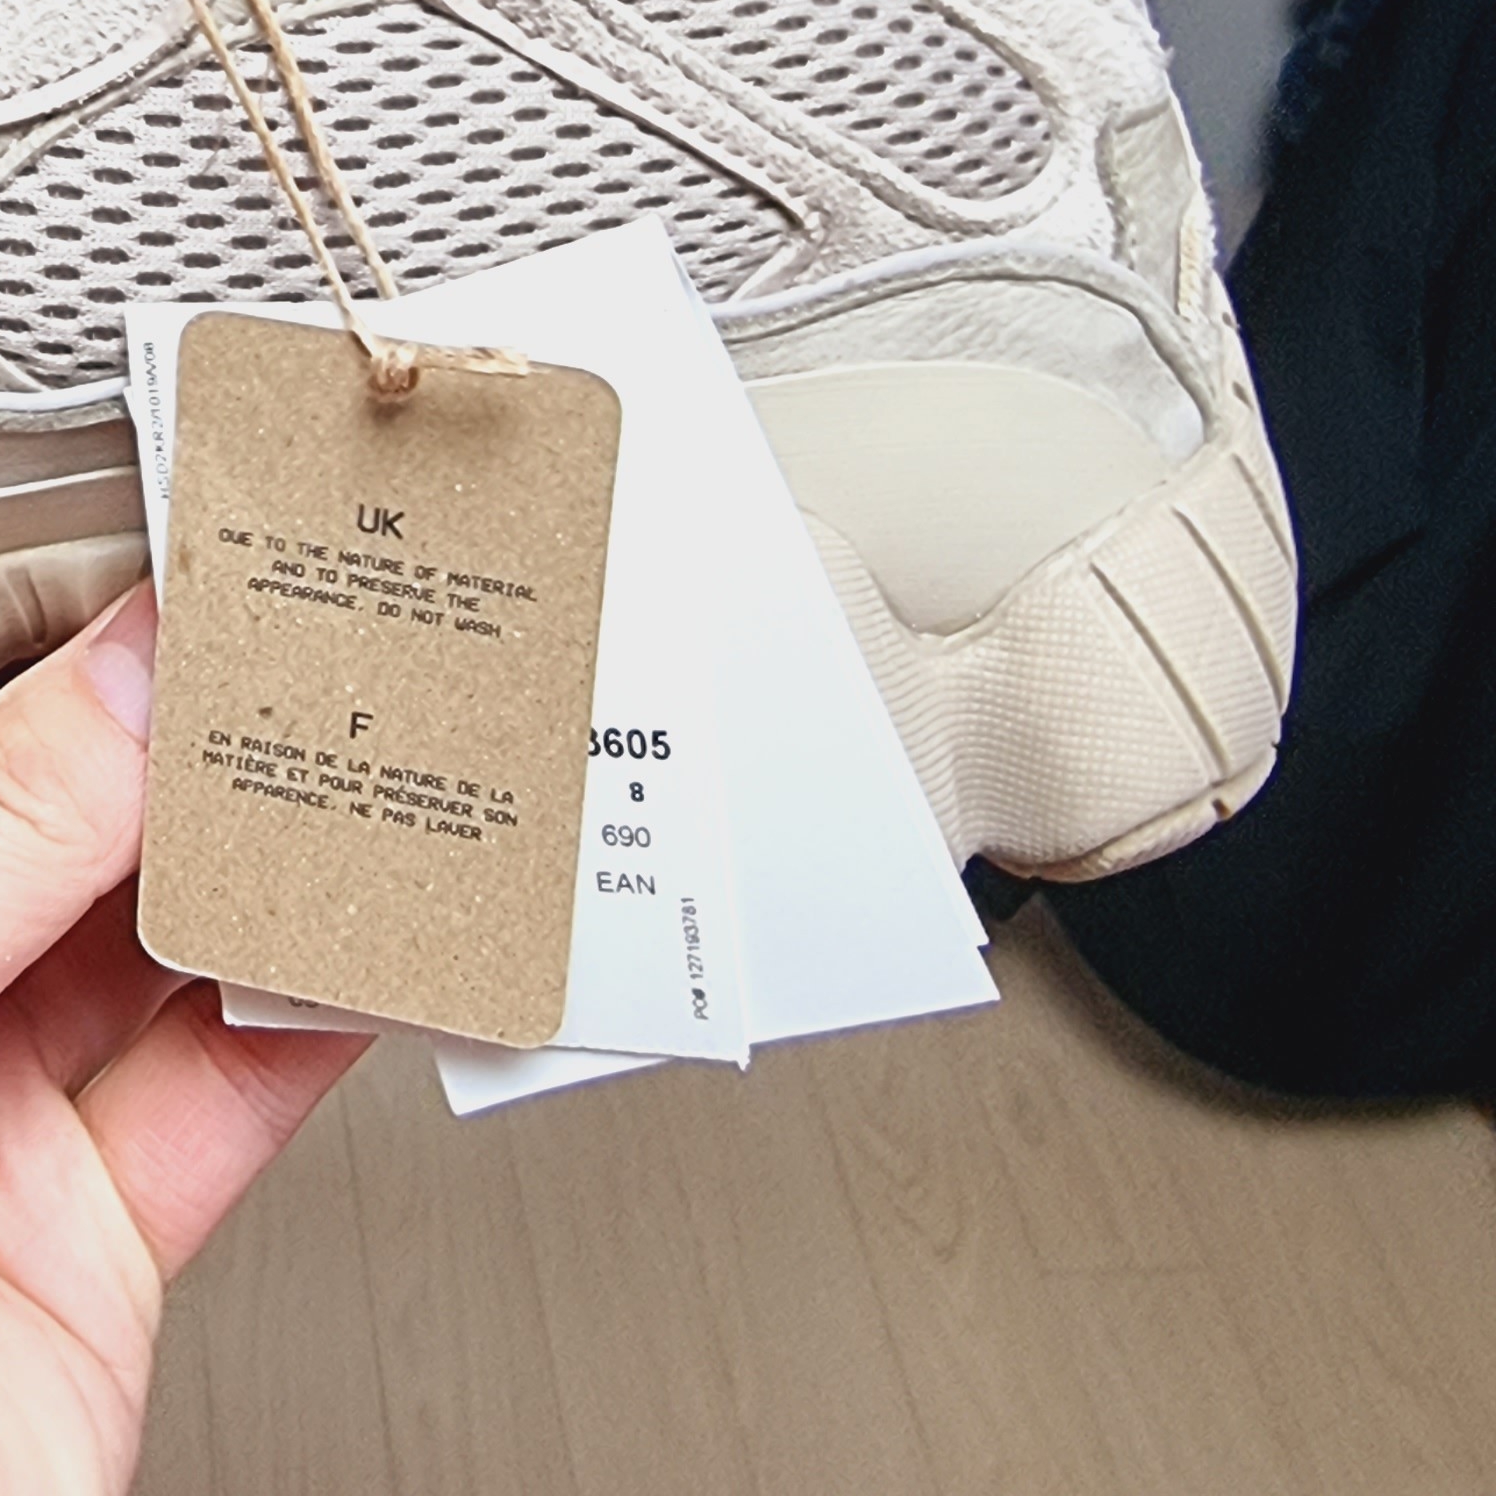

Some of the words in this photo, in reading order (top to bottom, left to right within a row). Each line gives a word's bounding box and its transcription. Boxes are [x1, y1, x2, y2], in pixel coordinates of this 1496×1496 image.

[357, 504, 404, 540] UK
[218, 528, 254, 547] DUE
[265, 535, 286, 553] TO
[297, 542, 329, 561] THE
[337, 551, 404, 576] NATURE
[414, 565, 438, 581] OF
[447, 572, 538, 602] MATERIAL
[271, 560, 305, 578] AND
[316, 567, 338, 584] TO
[347, 574, 435, 604] PRESERVE
[447, 593, 480, 612] THE
[377, 601, 401, 618] DO
[410, 607, 445, 627] NOT
[454, 616, 501, 638] WASH
[349, 711, 374, 739] F
[209, 730, 231, 747] EN
[240, 736, 306, 762] RAISON
[315, 751, 338, 769] DE
[347, 758, 371, 775] LA
[380, 765, 447, 792] NATURE
[457, 782, 481, 798] DE
[490, 787, 514, 805] LA
[203, 748, 278, 778] MATIÈRE
[286, 766, 309, 783] ET
[318, 772, 363, 795] POUR
[373, 781, 473, 818] PRÉSERVER
[483, 807, 518, 827] SON
[629, 781, 645, 803] 8
[349, 801, 373, 818] NE
[381, 807, 416, 828] PAS
[426, 816, 482, 841] LAVER
[601, 823, 651, 848] 690
[596, 871, 656, 895] EAN
